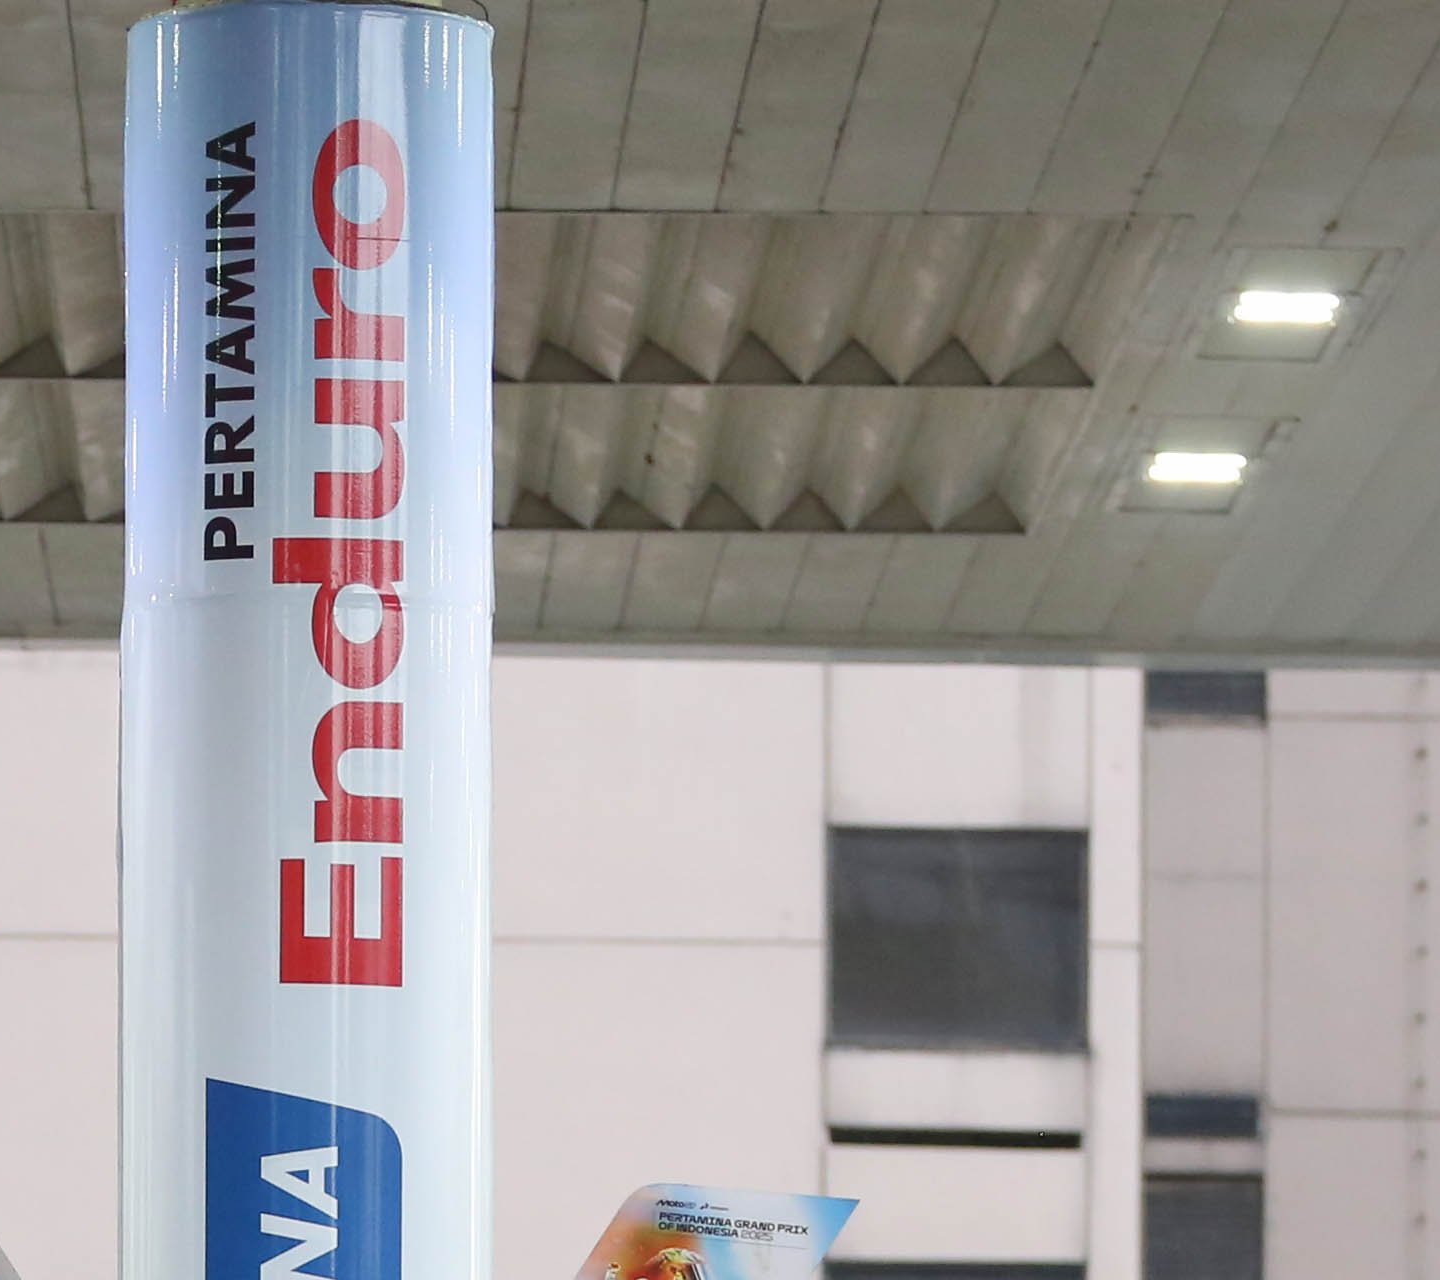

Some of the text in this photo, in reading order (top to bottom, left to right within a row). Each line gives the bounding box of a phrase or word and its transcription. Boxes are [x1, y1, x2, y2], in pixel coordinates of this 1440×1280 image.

[203, 120, 257, 562] PERTAMINA
[271, 117, 409, 988] Enduro
[658, 1211, 809, 1235] PERTAMINA GRAND PRIX
[658, 1221, 673, 1231] OF
[676, 1222, 739, 1237] INDONESIA
